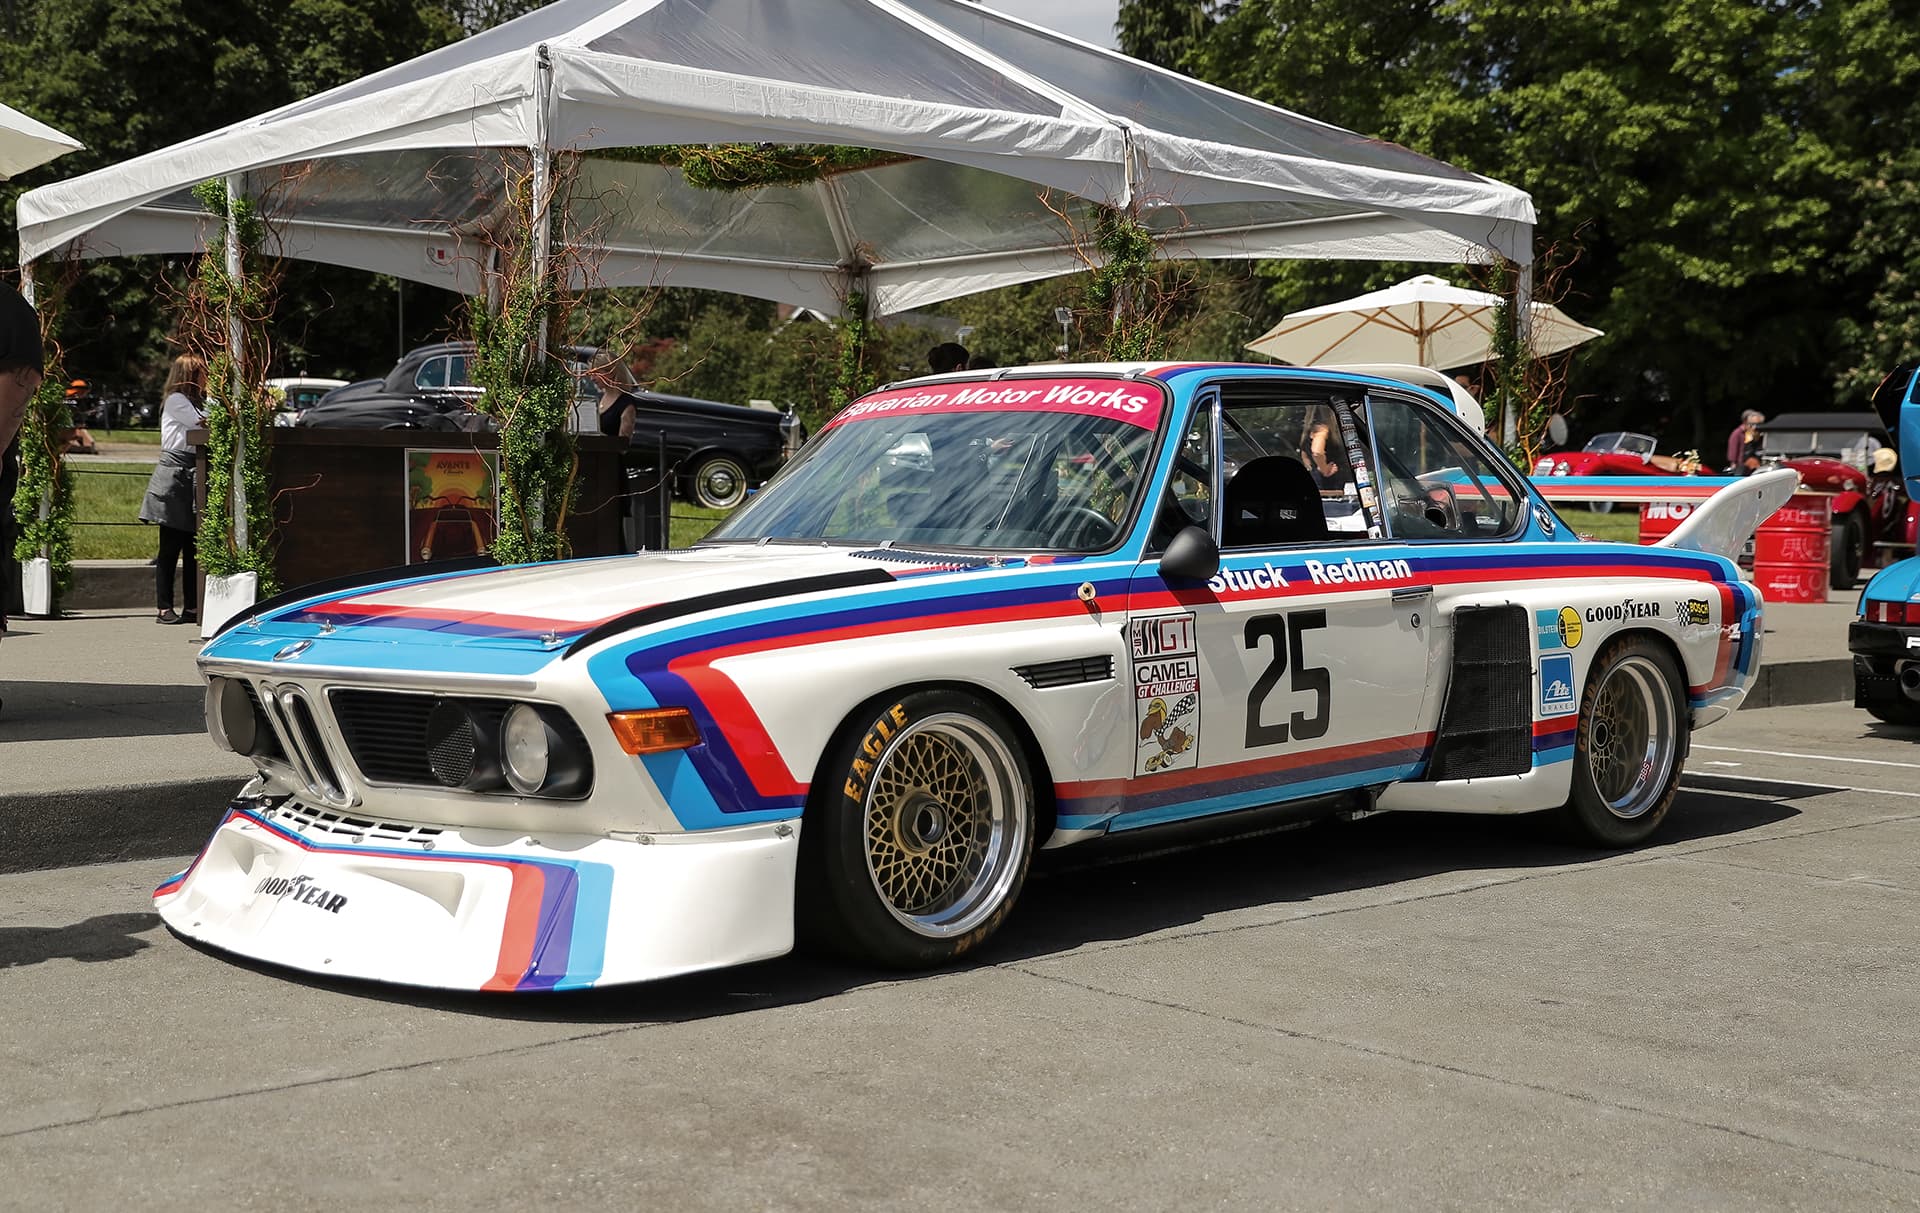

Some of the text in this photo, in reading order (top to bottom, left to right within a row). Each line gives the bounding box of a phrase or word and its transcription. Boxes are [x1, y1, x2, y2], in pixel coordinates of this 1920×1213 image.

[838, 385, 1149, 421] Bavarian Motor Works
[1207, 557, 1412, 593] Stuck Redman
[1689, 602, 1709, 615] BOSCH
[1159, 618, 1193, 651] GT
[1137, 661, 1196, 684] CAMEL
[1244, 608, 1331, 749] 25
[1138, 680, 1196, 698] GT CHALLENGE
[1542, 702, 1575, 713] BRAKES
[844, 704, 908, 803] EAGLE
[1640, 762, 1650, 781] BBS
